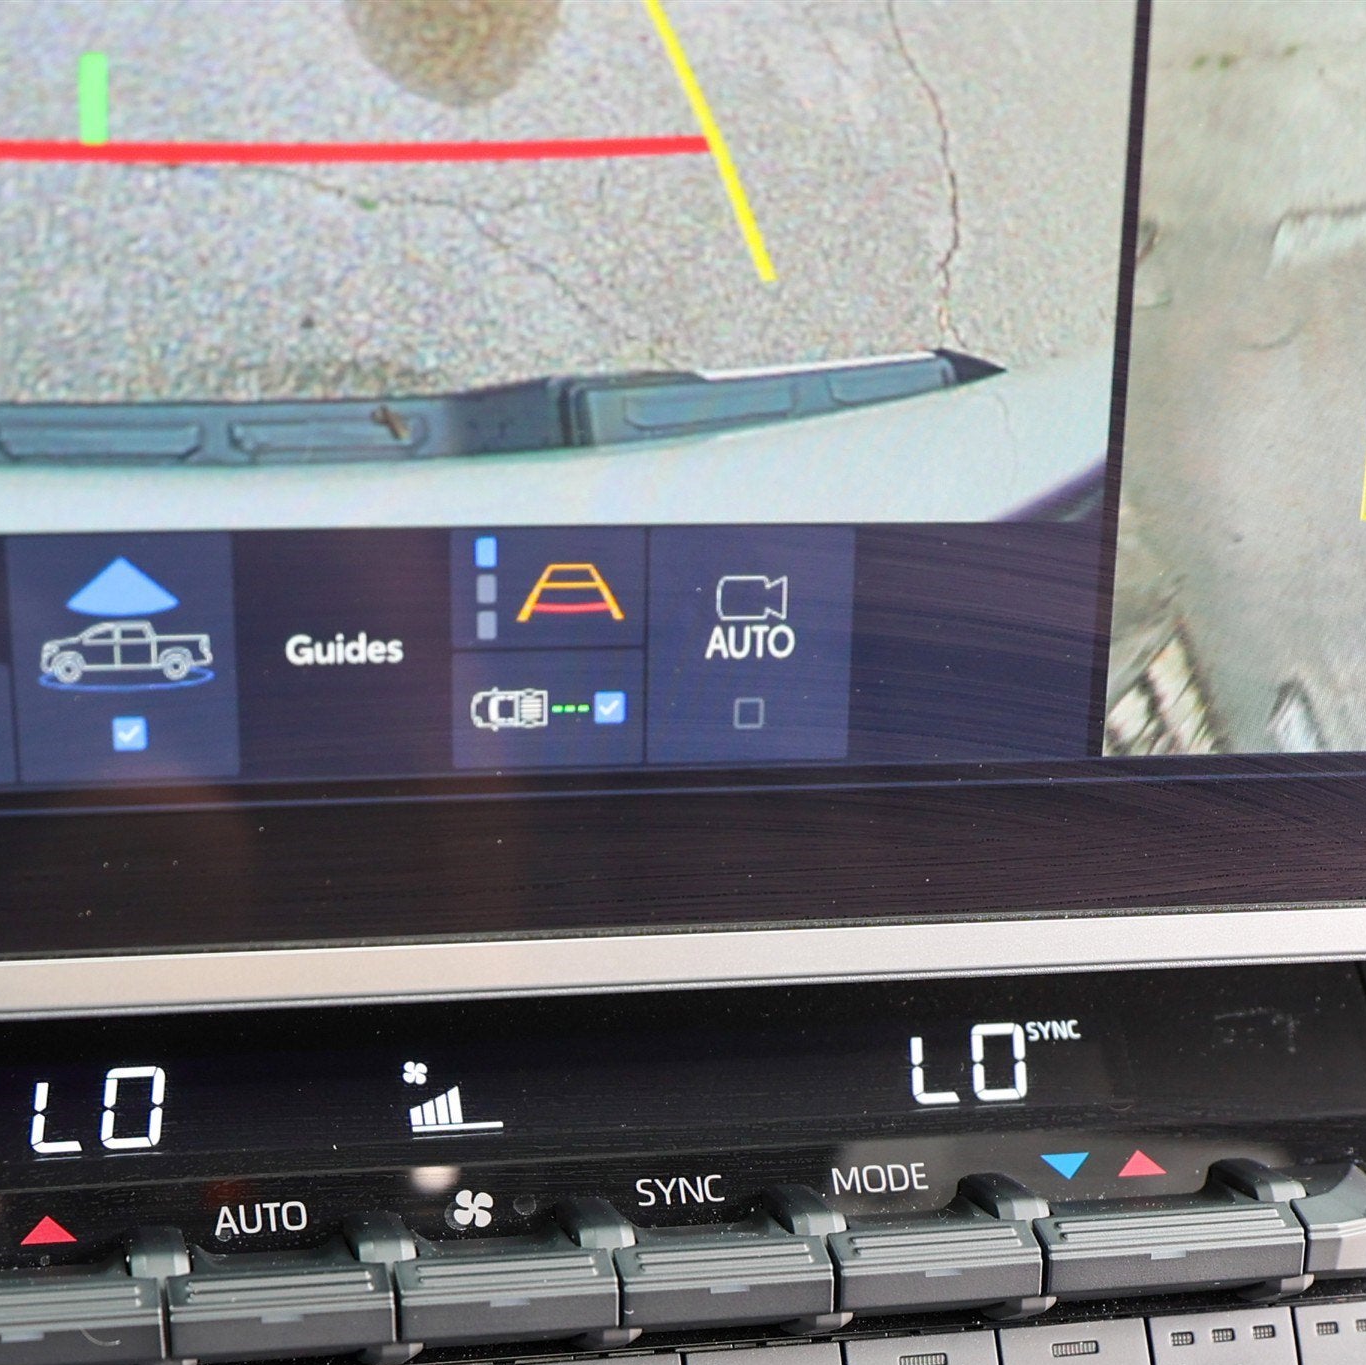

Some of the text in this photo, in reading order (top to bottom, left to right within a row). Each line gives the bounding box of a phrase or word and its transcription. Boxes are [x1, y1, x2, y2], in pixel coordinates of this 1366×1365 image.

[285, 633, 404, 666] Guides
[705, 625, 795, 659] AUTO
[1025, 1019, 1081, 1041] SYNC
[635, 1174, 726, 1207] SYNC
[831, 1162, 929, 1195] MODE
[214, 1200, 308, 1236] AUTO
